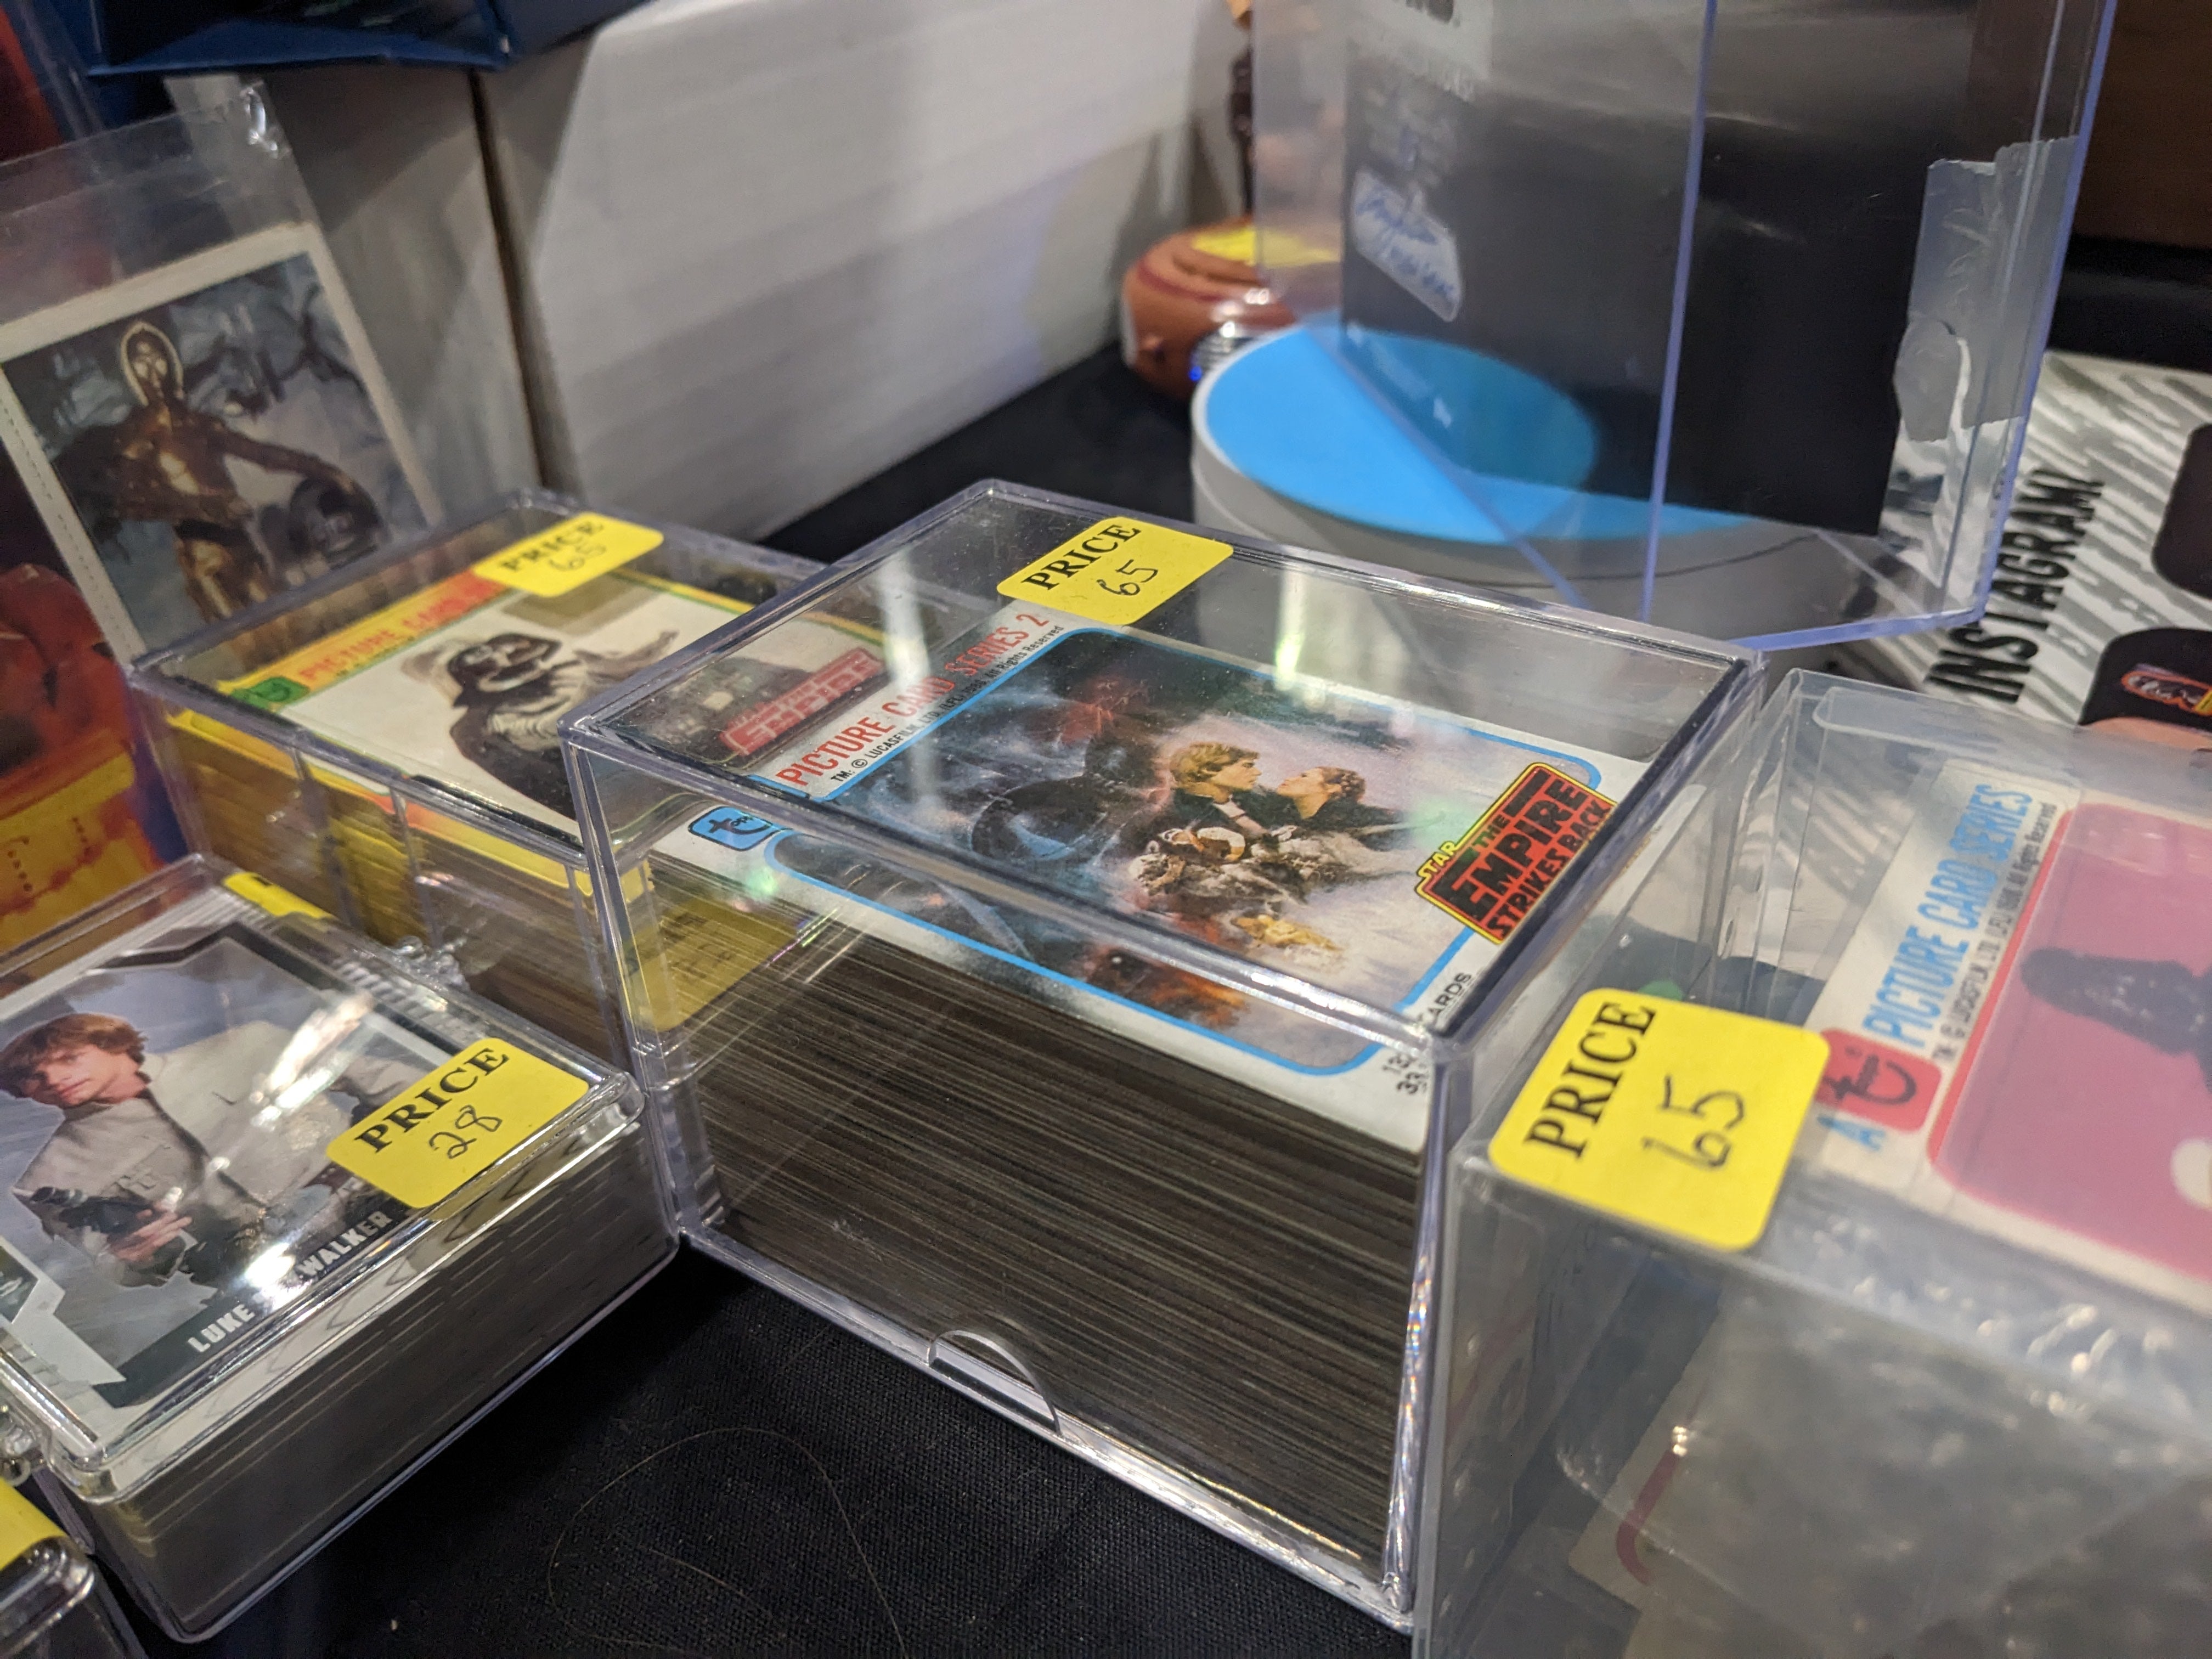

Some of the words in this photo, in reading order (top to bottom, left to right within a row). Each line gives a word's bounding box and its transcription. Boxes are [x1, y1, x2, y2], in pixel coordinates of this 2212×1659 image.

[499, 521, 604, 572] PRICE
[1020, 524, 1142, 591] PRICE
[1096, 559, 1159, 596] 65
[1924, 468, 2105, 704] INSTAGRAM
[996, 651, 1028, 670] Rights
[1022, 625, 1065, 652] Reserved
[775, 716, 895, 786] PICTURE
[882, 675, 955, 718] CARD
[945, 627, 1029, 676] SERIES
[1015, 612, 1049, 627] 2
[1417, 840, 1456, 879] STAR
[1430, 769, 1589, 922] EMPIRE
[1470, 814, 1510, 849] THE
[1949, 783, 2033, 862] SERIES
[1485, 848, 1570, 938] STRIKES
[1556, 800, 1613, 853] BACK
[1916, 858, 1998, 930] CARD
[1862, 924, 1970, 1048] PICTURE
[353, 1047, 510, 1154] PRICE
[1523, 1001, 1657, 1161] PRICE
[428, 1104, 503, 1160] 28
[1644, 1074, 1746, 1168] 65
[187, 1304, 256, 1353] LUKE
